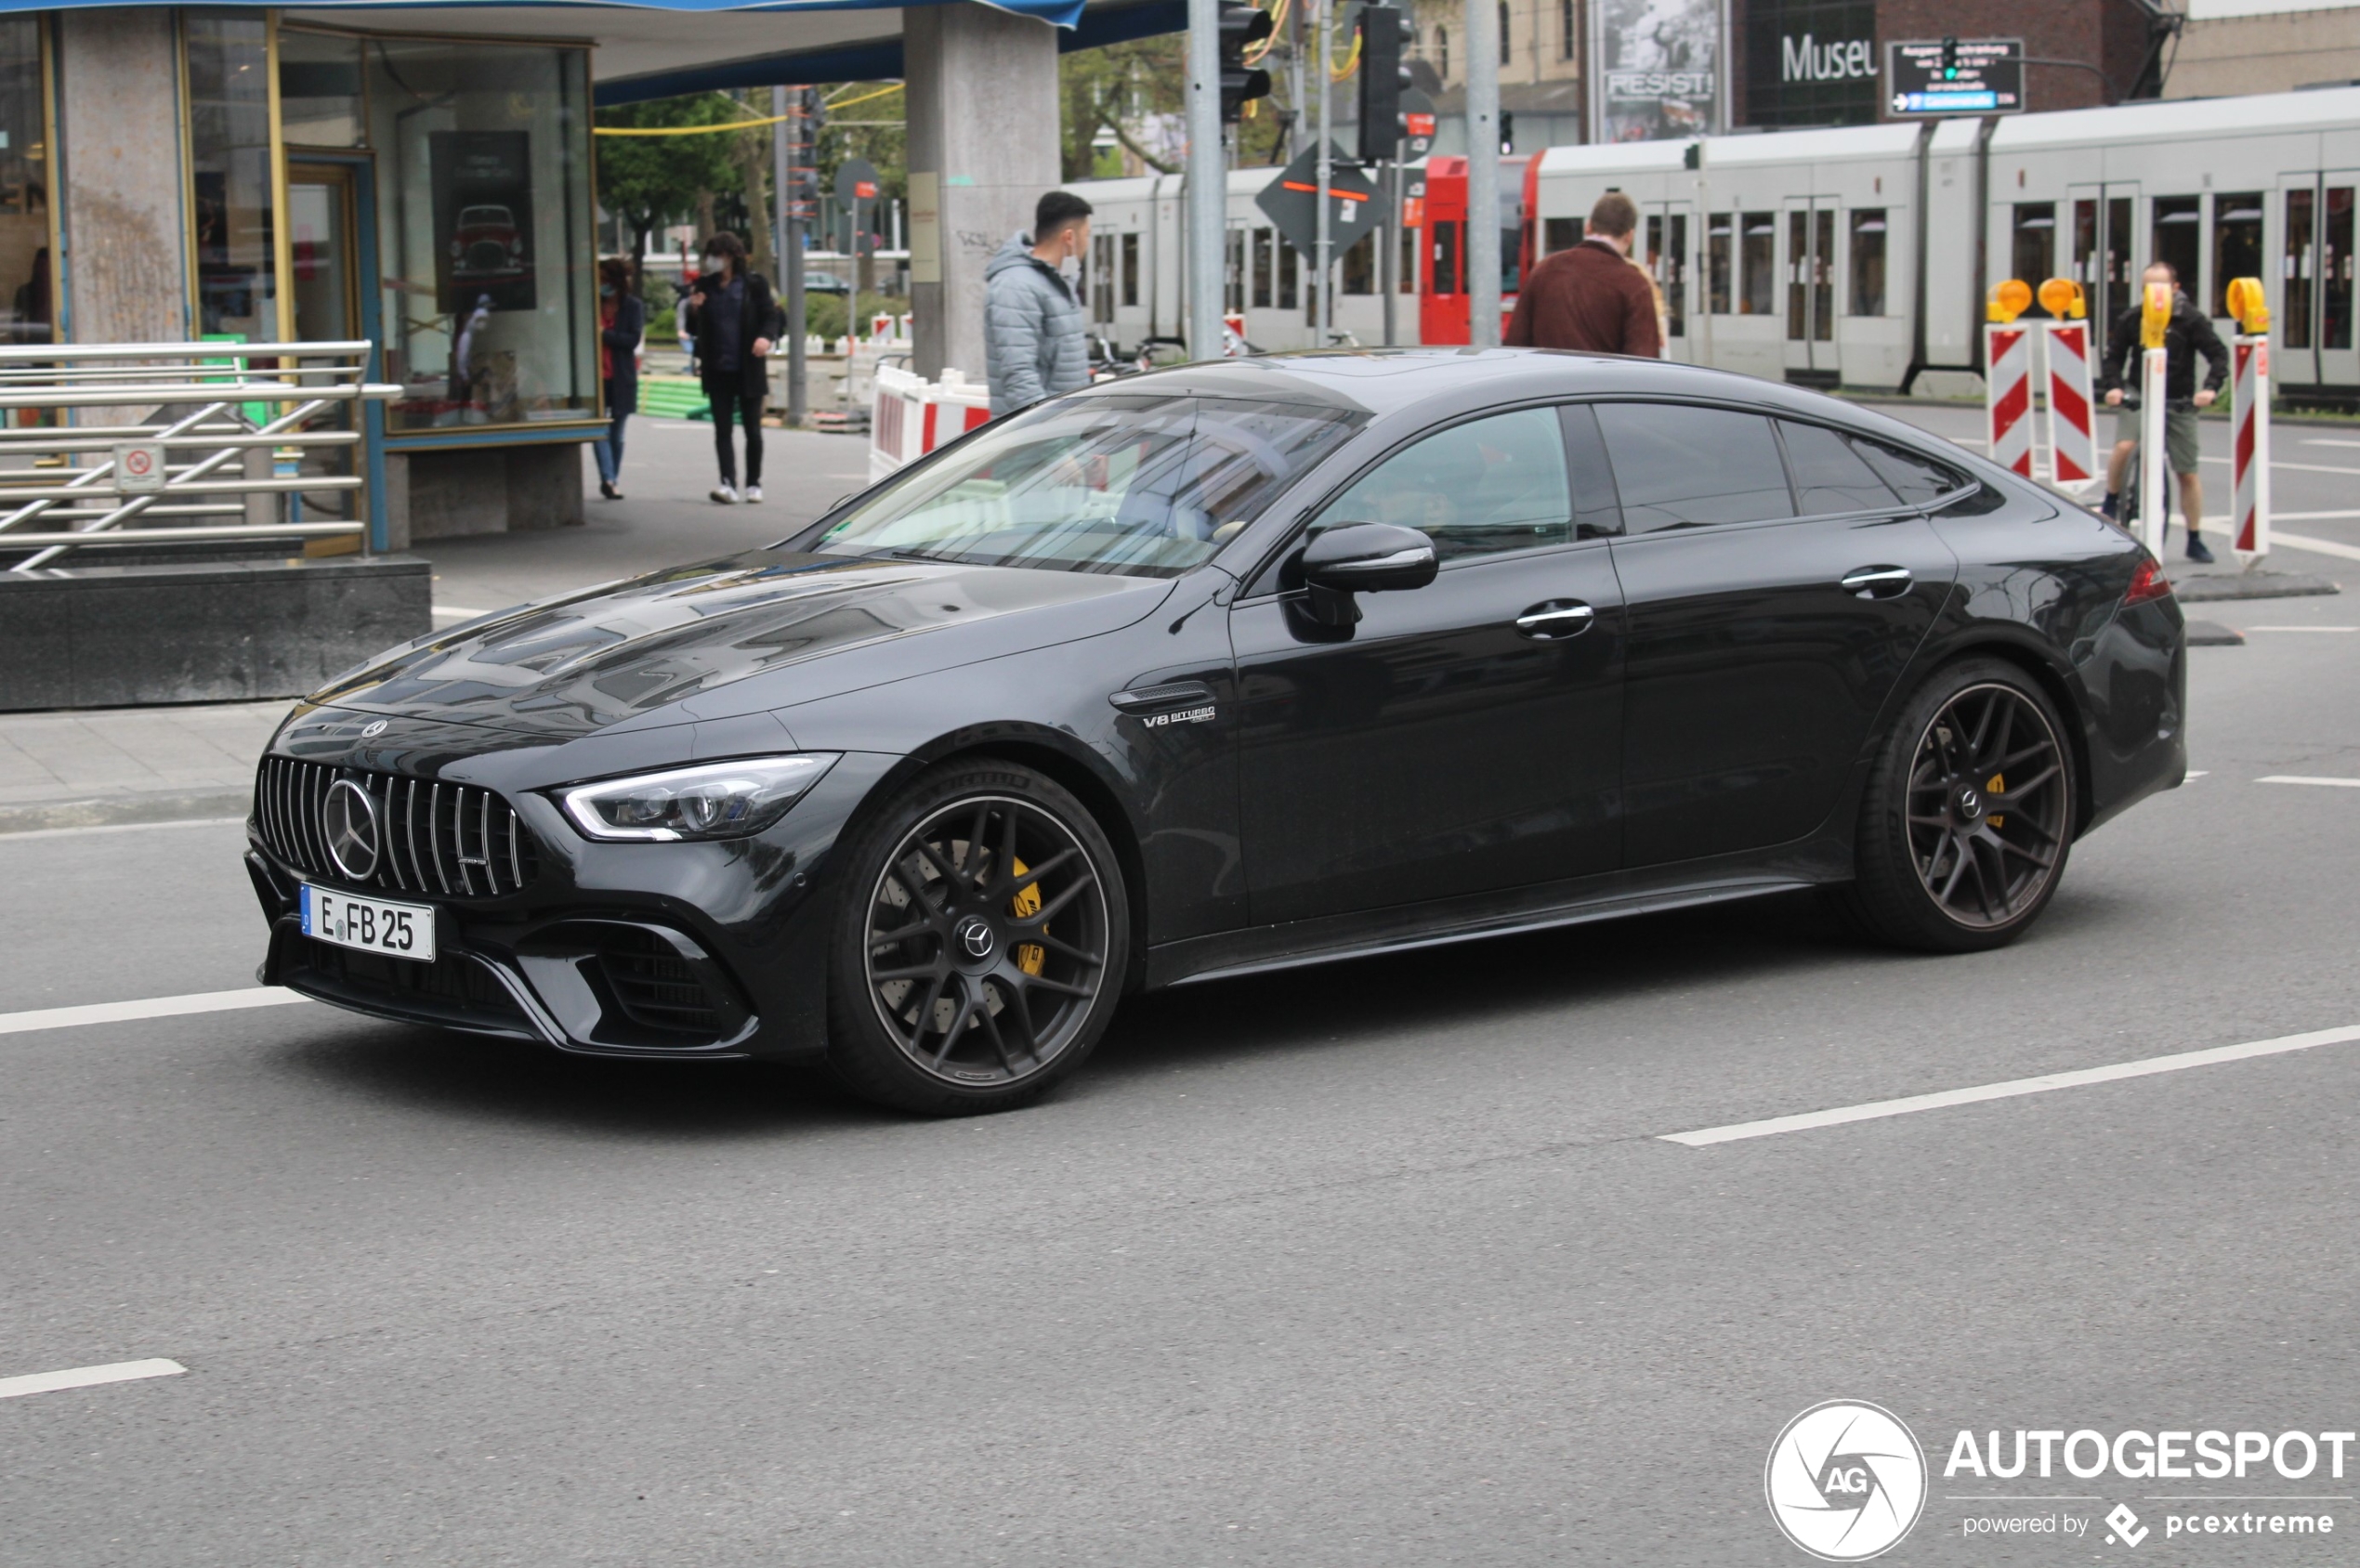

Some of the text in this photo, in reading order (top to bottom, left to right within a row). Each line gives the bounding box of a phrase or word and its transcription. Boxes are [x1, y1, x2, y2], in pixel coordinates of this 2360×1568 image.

[1607, 72, 1714, 95] RESIST!
[1143, 706, 1215, 728] V8 BITURBO
[304, 914, 309, 926] D
[321, 895, 413, 950] E FB 25
